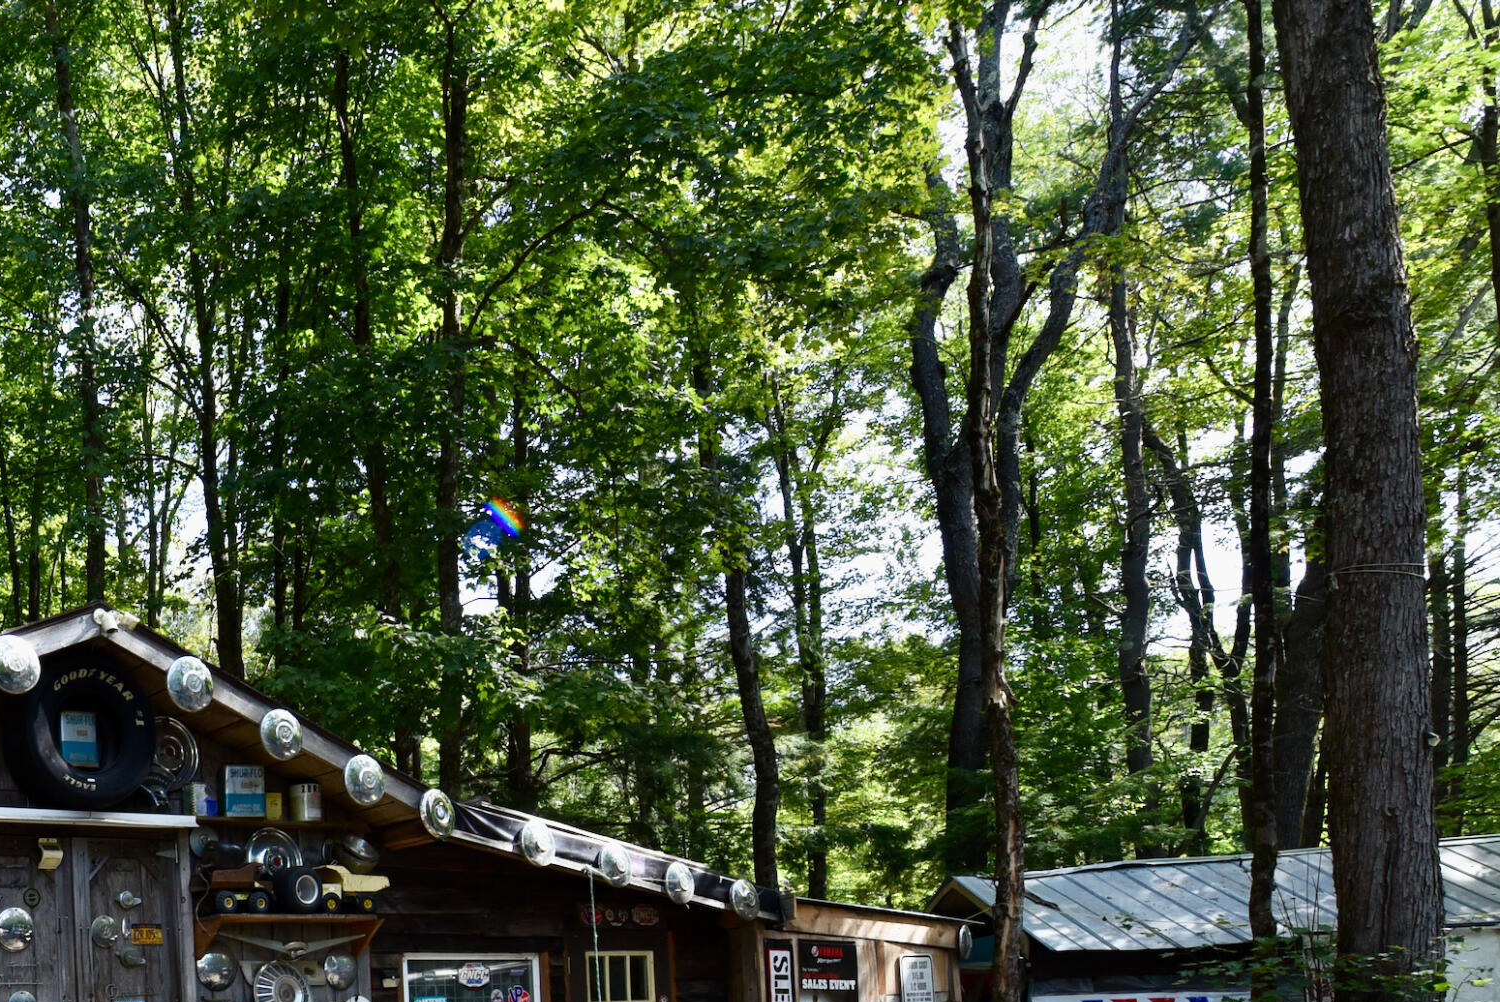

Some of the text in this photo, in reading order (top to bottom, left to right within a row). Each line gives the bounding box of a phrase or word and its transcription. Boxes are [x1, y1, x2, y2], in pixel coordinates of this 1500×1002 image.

[53, 668, 134, 701] GOODYEAR
[63, 773, 97, 791] EAGLE
[459, 969, 489, 980] GNCC
[802, 978, 856, 991] SALES EVENT
